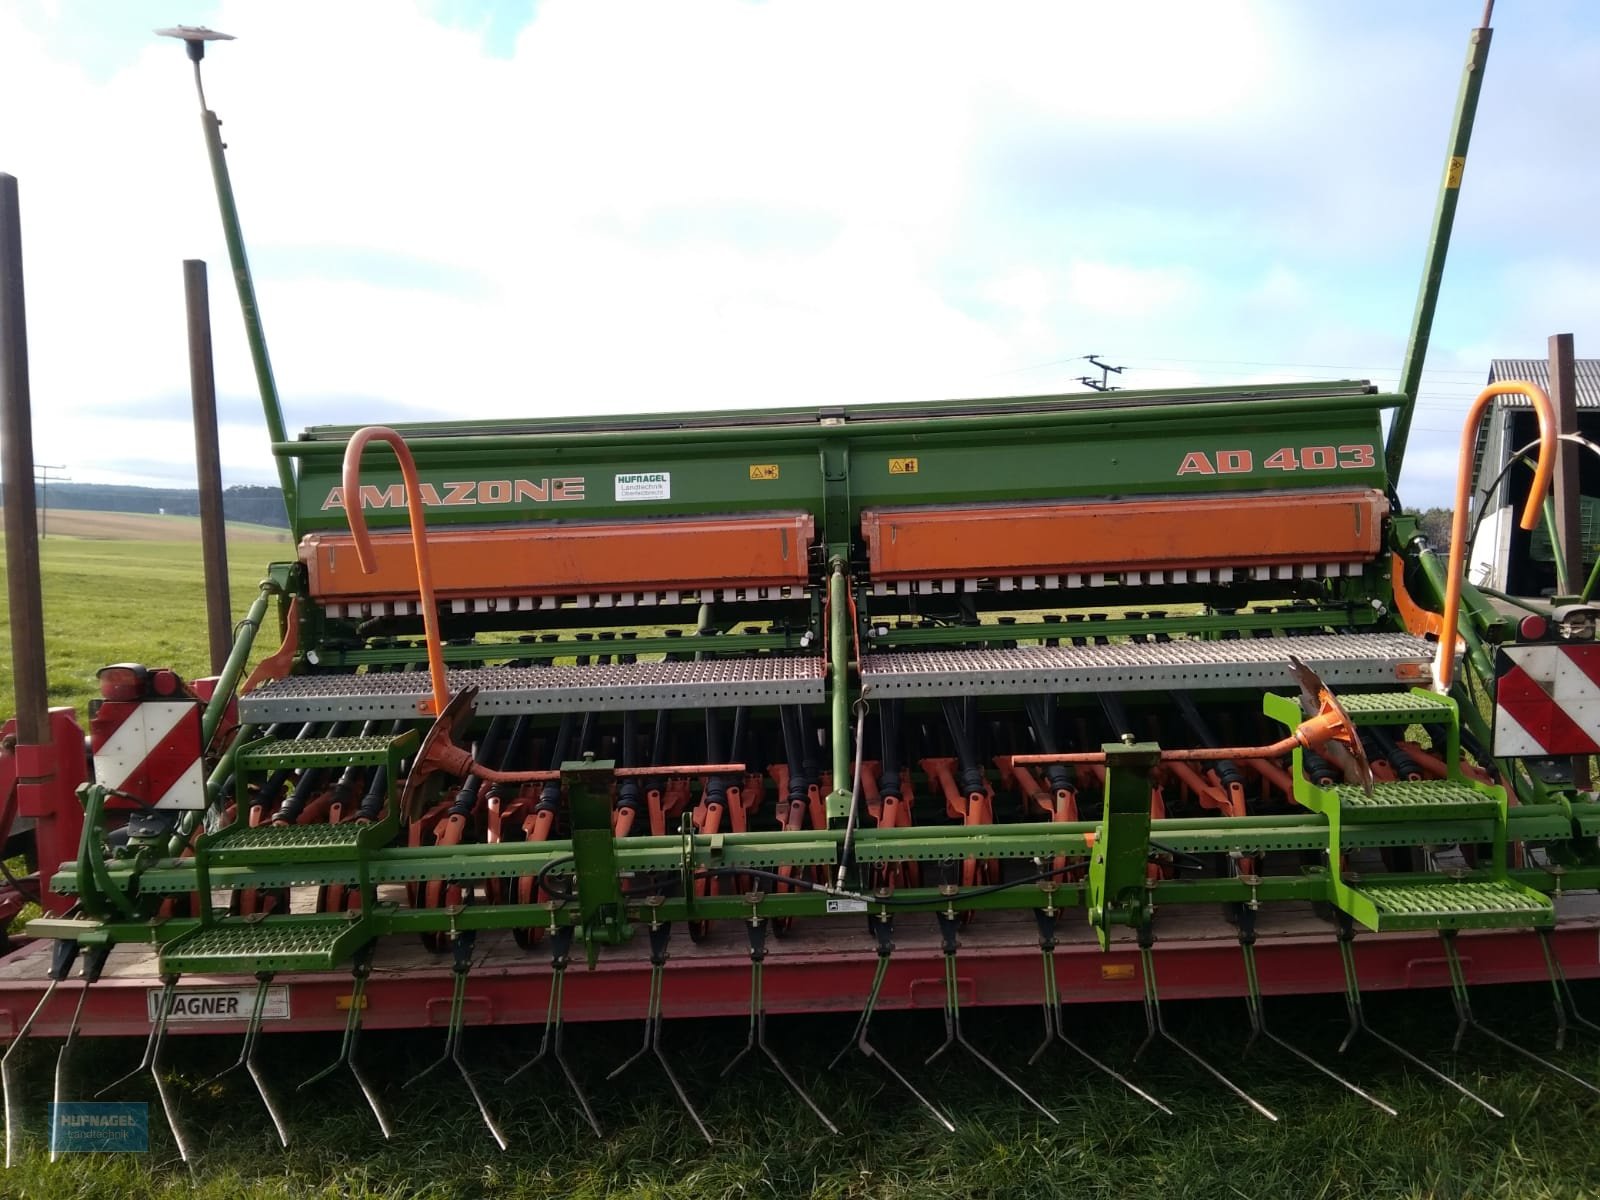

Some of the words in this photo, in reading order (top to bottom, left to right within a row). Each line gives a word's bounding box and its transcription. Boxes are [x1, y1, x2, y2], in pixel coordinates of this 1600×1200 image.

[1177, 450, 1253, 475] AD
[1264, 445, 1375, 470] 403
[320, 477, 585, 511] AMAZONE
[618, 475, 666, 483] HUFNAGEL
